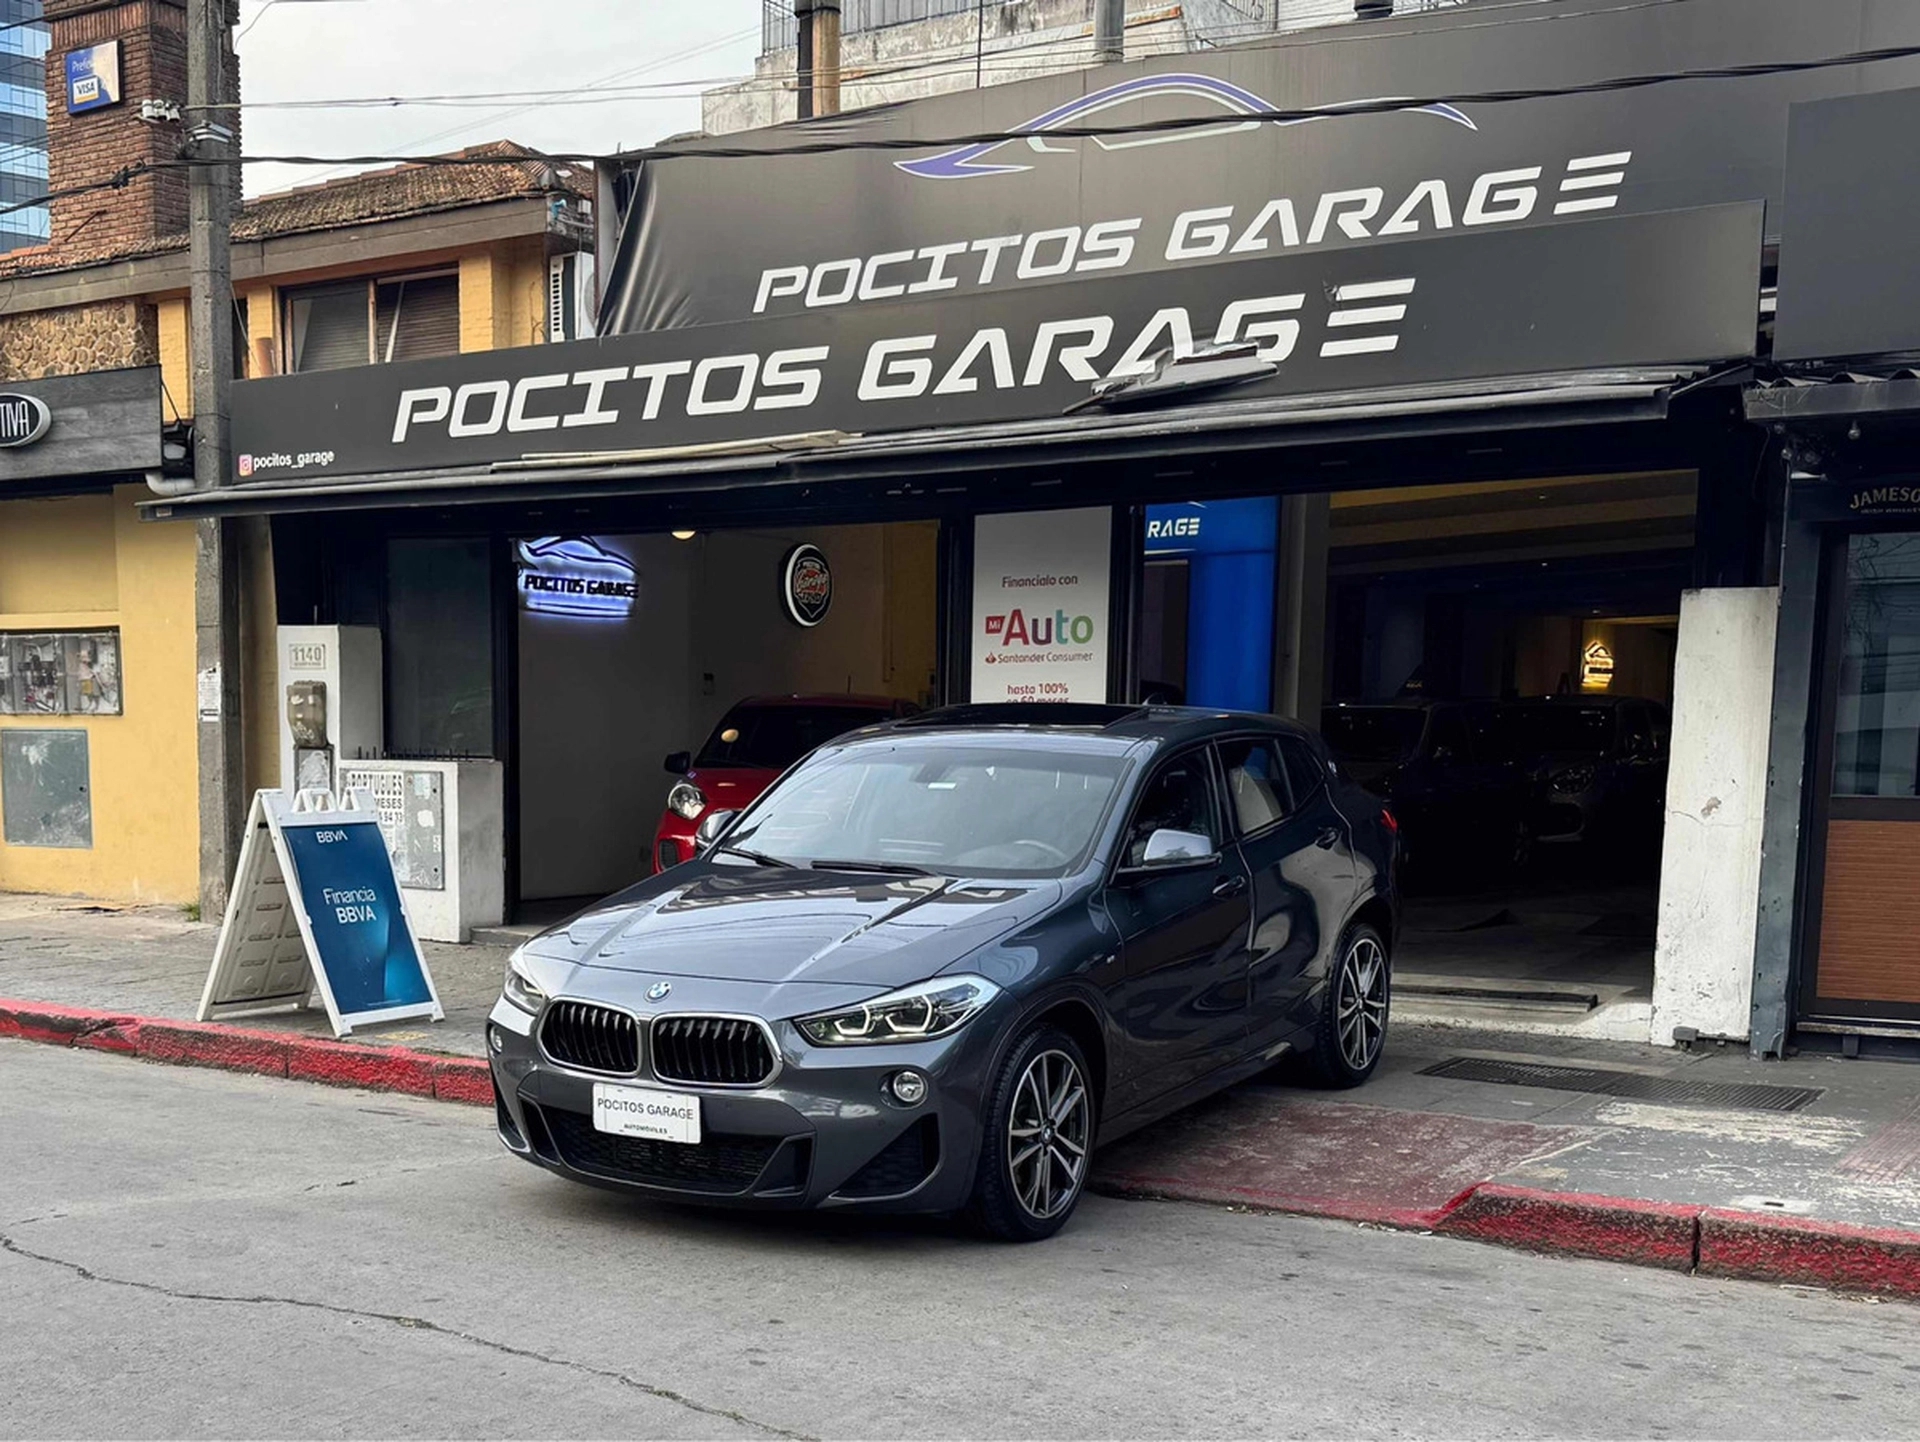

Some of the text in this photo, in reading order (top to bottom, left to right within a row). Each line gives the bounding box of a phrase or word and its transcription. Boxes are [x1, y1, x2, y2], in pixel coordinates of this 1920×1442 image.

[76, 81, 96, 95] VISA
[752, 151, 1632, 313] POCITOS GARAGE
[392, 278, 1416, 443] POCITOS GARAGE
[253, 450, 335, 472] pocitos_garage
[1147, 517, 1201, 538] RAGE
[524, 574, 586, 593] POCITOS
[1058, 575, 1078, 585] con
[1002, 609, 1094, 646] Auto
[293, 647, 321, 661] 1140
[998, 652, 1093, 663] Santander Consumer
[1007, 683, 1069, 695] hasta 100%
[316, 829, 349, 844] BBVA
[323, 886, 377, 905] Financia
[335, 907, 377, 924] BBVA
[597, 1098, 694, 1120] POCITOS GARAGE
